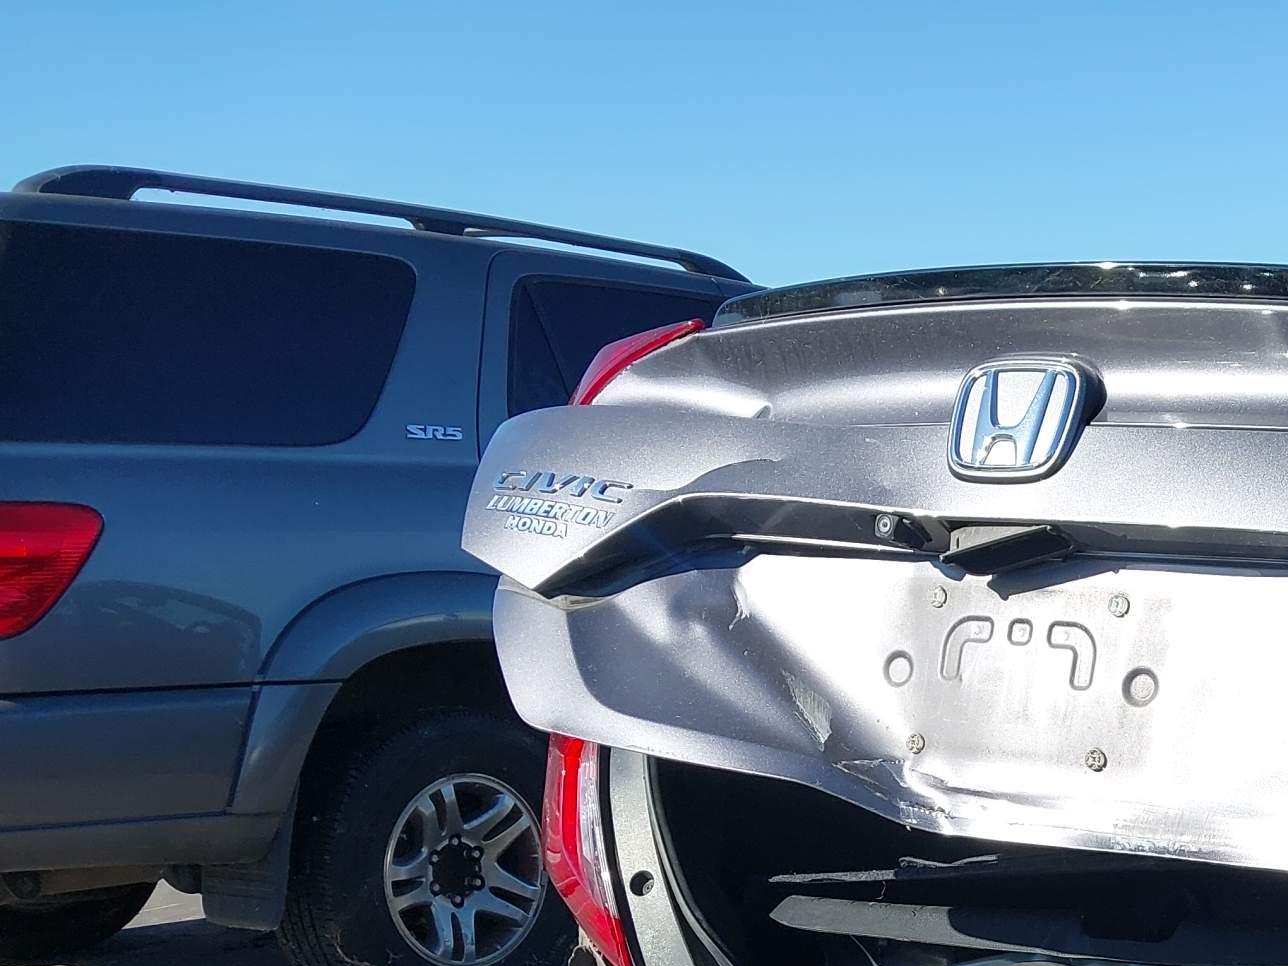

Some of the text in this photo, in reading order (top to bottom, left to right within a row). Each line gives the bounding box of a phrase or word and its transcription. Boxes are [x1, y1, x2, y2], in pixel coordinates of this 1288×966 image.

[406, 424, 463, 441] SR5
[494, 471, 634, 504] CIVIC
[485, 494, 616, 528] LUMBERTON
[504, 514, 569, 538] HONDA
